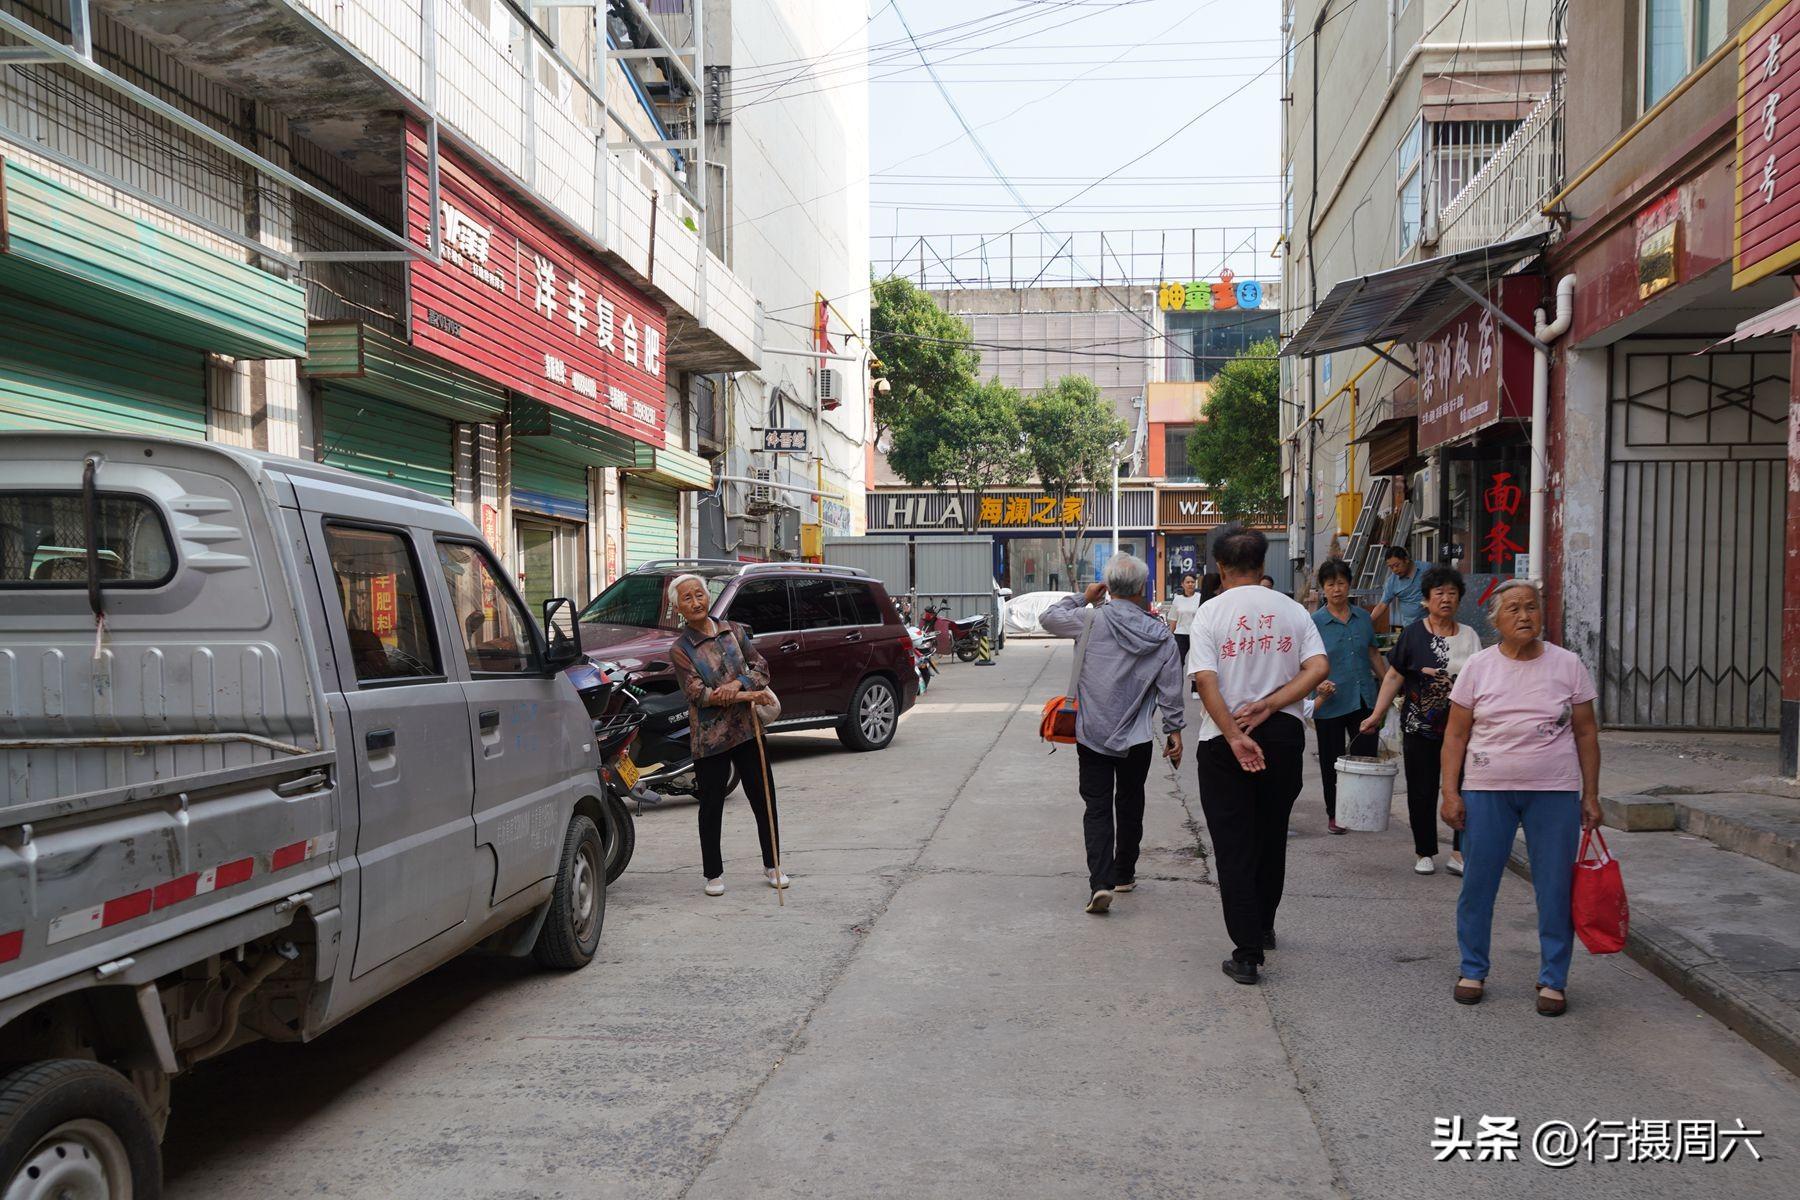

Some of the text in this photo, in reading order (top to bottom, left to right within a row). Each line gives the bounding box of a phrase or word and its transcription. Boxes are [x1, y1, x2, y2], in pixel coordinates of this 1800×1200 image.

[534, 253, 660, 377] 洋丰复合肥
[886, 496, 1085, 526] HLA 海澜之家
[1236, 614, 1276, 632] 天河
[1220, 634, 1293, 660] 建材市场
